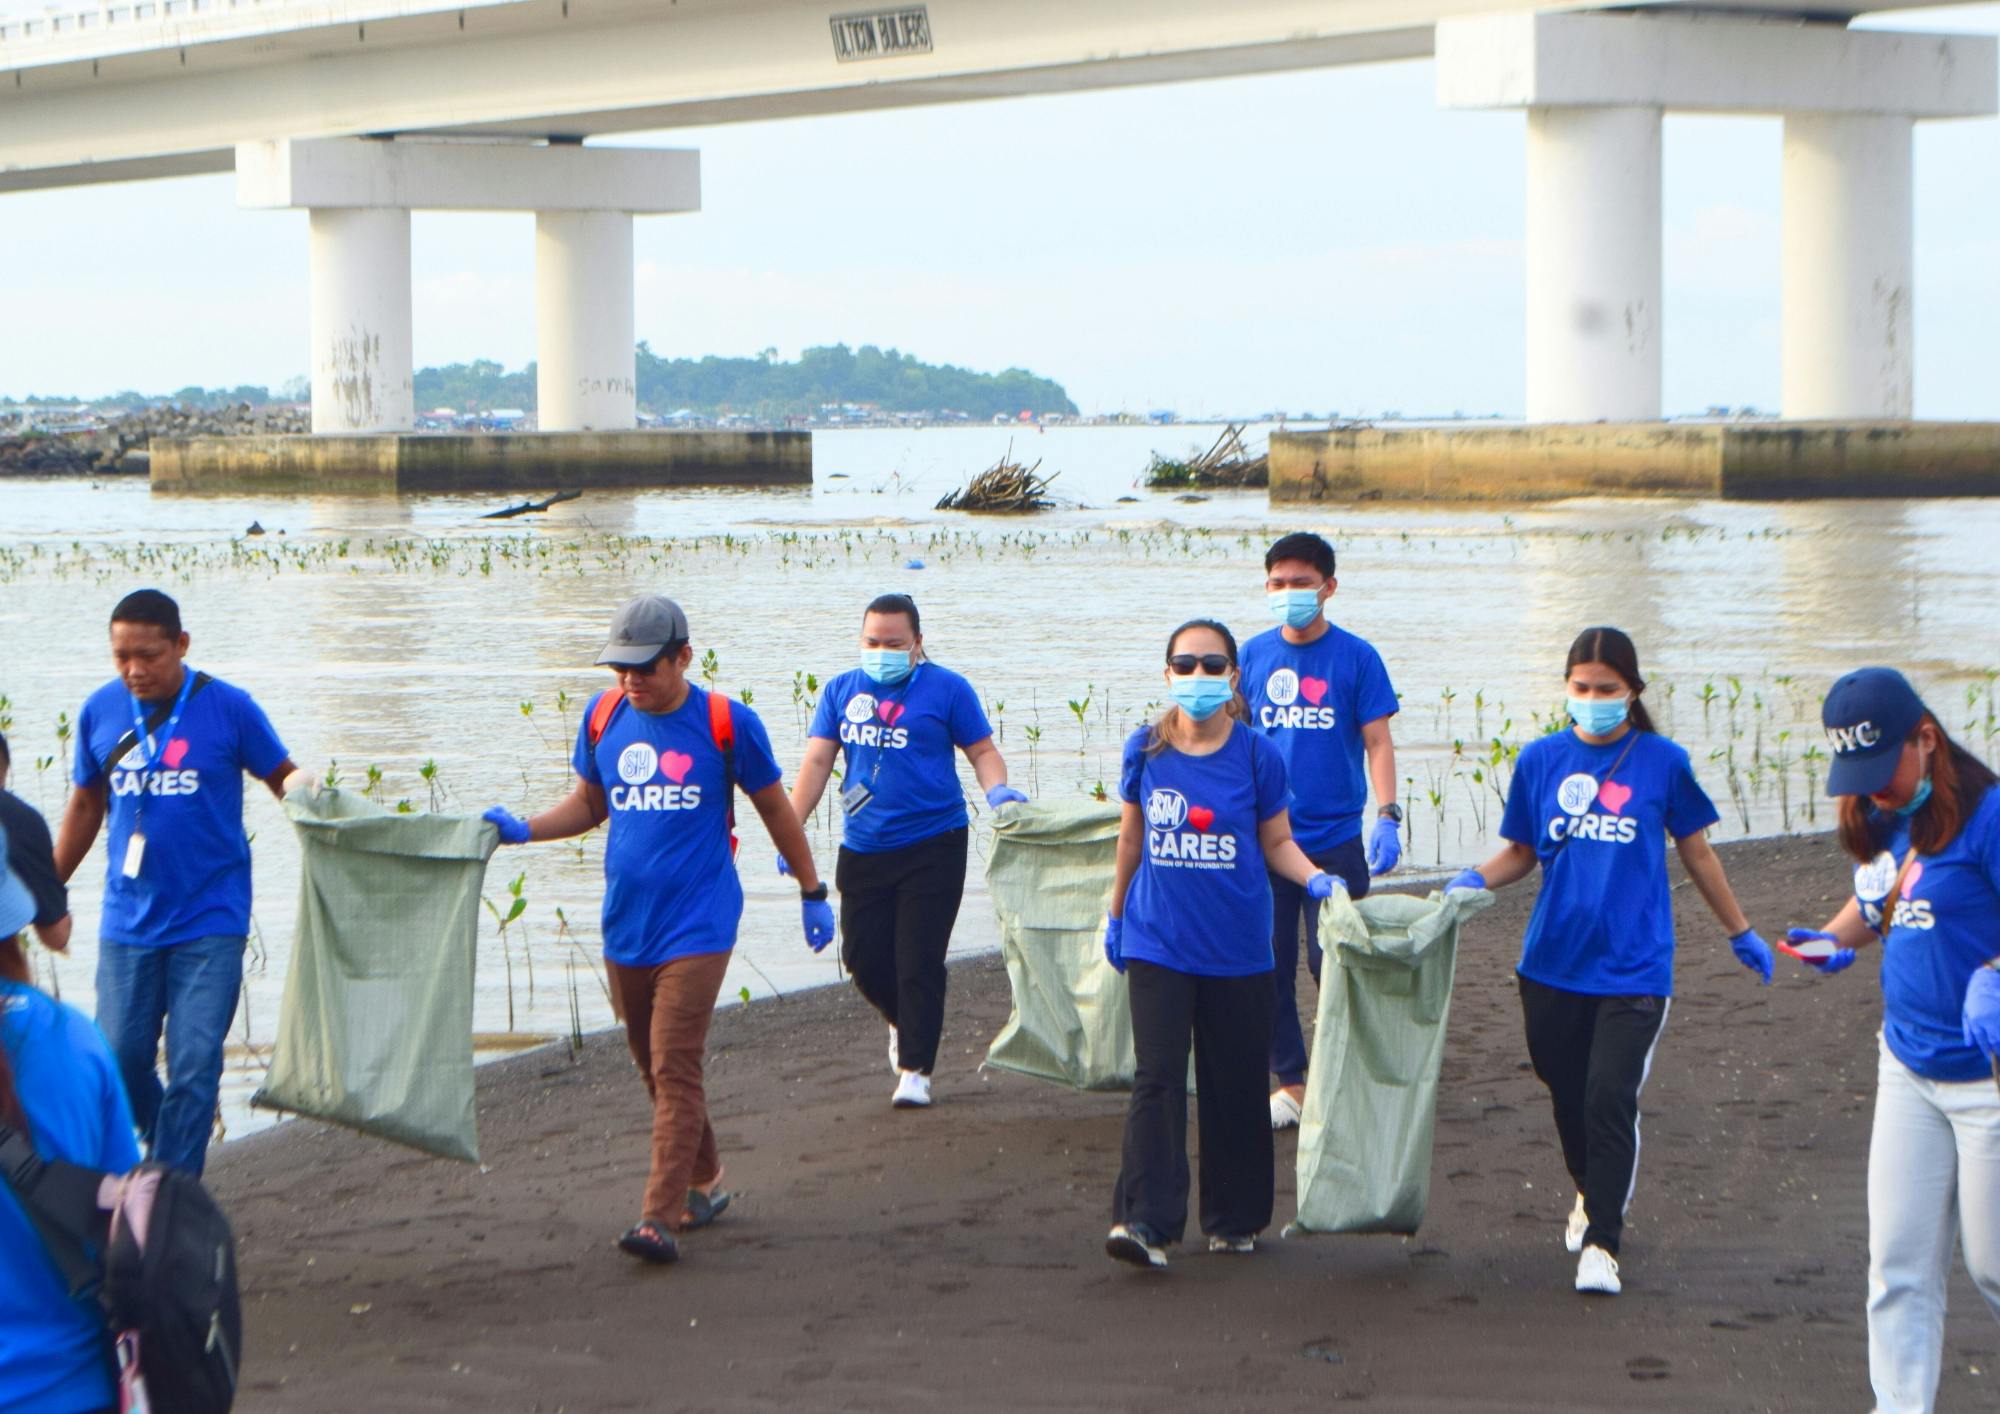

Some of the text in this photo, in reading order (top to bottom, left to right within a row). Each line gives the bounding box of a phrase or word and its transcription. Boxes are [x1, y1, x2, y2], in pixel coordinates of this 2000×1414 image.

[1260, 706, 1335, 730] CARES
[840, 723, 909, 749] CARES
[610, 785, 702, 812] CARES
[1148, 791, 1183, 828] SM
[1149, 830, 1237, 862] CARES
